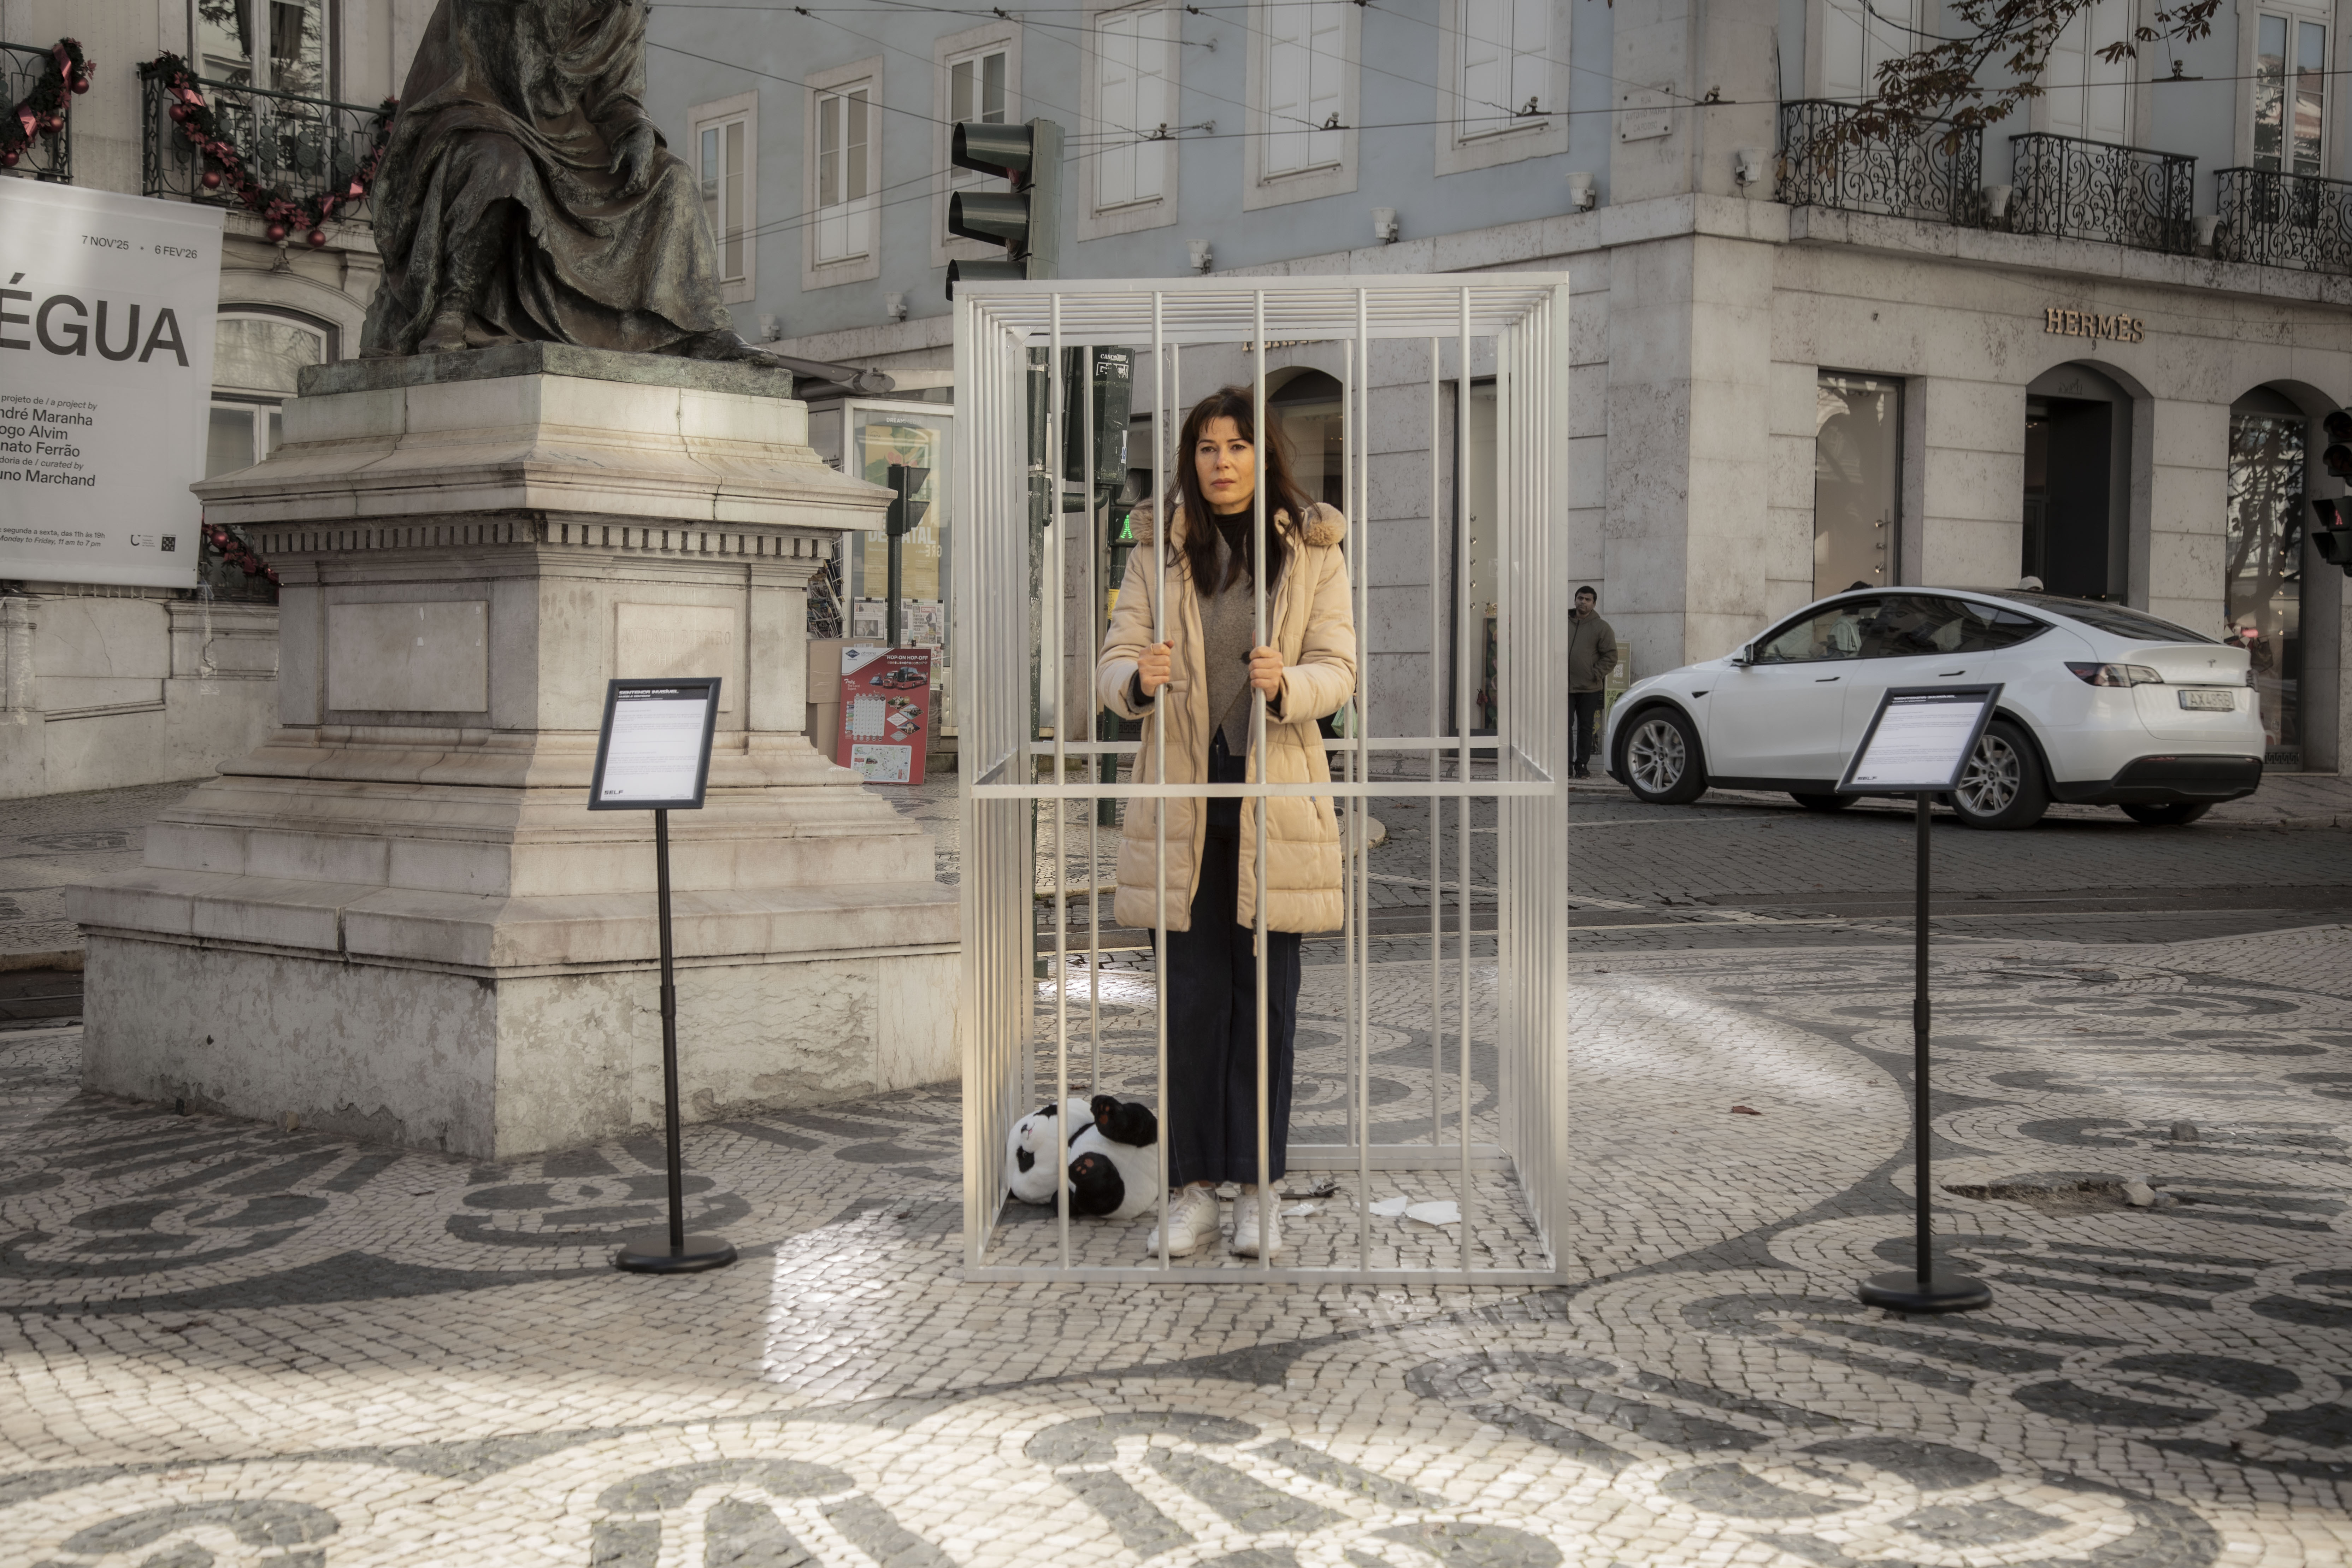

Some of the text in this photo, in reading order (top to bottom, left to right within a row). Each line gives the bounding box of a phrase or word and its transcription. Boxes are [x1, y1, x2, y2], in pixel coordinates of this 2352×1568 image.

[1640, 95, 1651, 105] RUA
[1633, 122, 1657, 132] CARDOSO
[81, 235, 88, 244] 7
[155, 246, 161, 254] 6
[2092, 340, 2097, 351] 9
[1, 395, 31, 404] projeto
[33, 396, 44, 405] de
[57, 399, 87, 409] project
[88, 402, 98, 411] by
[33, 409, 93, 426] Maranha
[29, 424, 68, 440] Alvim
[36, 442, 80, 458] Ferrão
[41, 459, 72, 469] curated
[74, 462, 84, 471] by
[25, 469, 96, 487] Marchand
[34, 537, 56, 546] Friday,
[902, 526, 936, 545] ATAL
[648, 652, 706, 668] CHIADO
